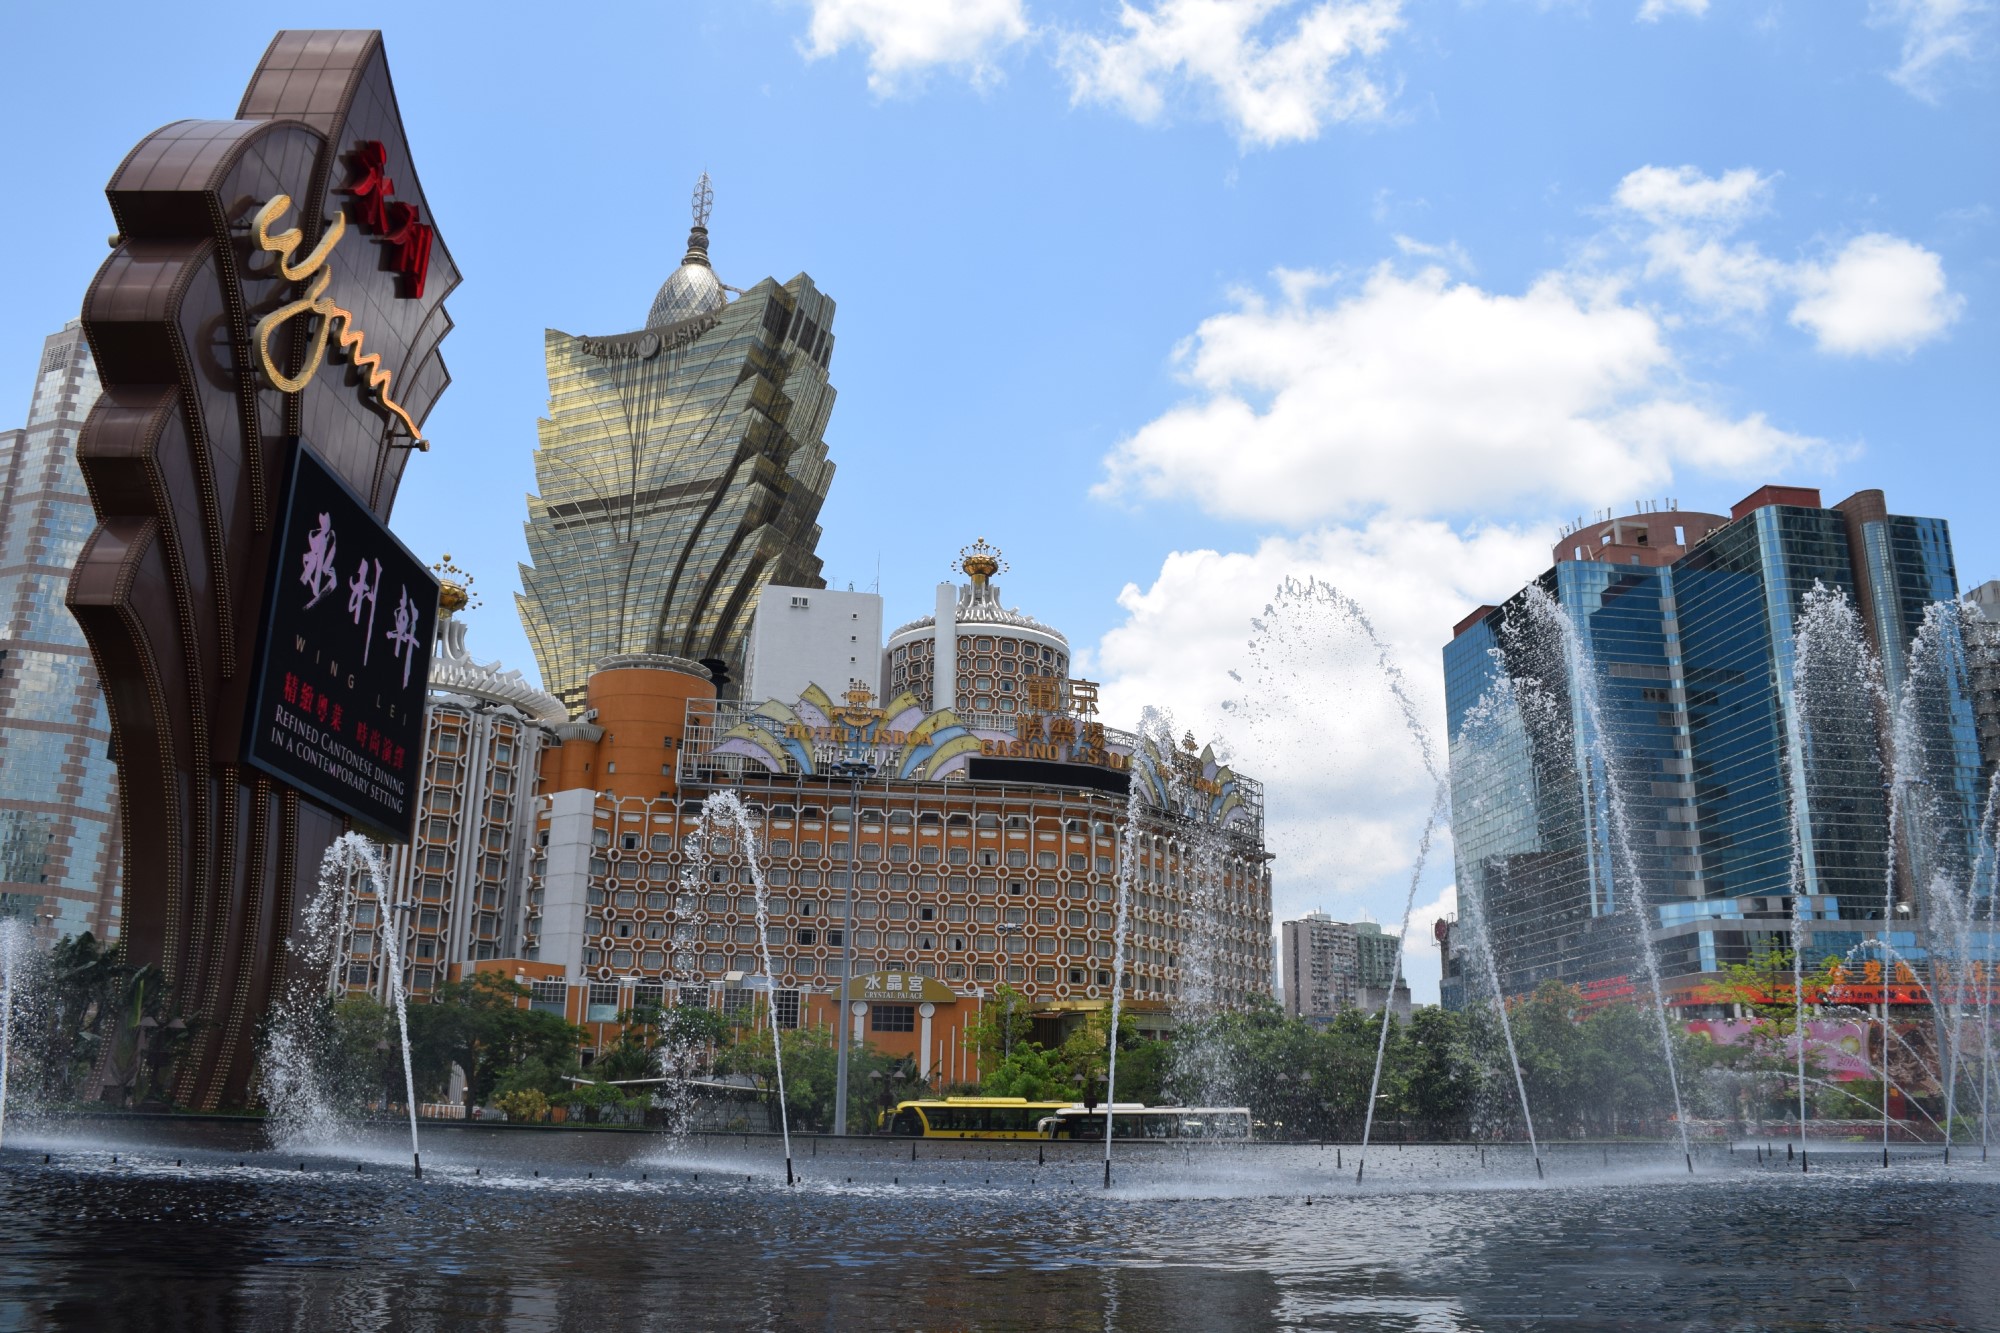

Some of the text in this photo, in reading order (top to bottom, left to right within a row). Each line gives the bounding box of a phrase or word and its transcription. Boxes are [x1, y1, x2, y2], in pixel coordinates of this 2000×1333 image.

[582, 316, 722, 358] GRAND LISBOA
[296, 634, 407, 726] WING LEI
[1028, 674, 1100, 715] 葡京
[275, 704, 405, 796] REFINED CANTONESE DINING
[784, 725, 934, 746] HOTEL LISBOA
[981, 739, 1059, 761] CASINO
[271, 727, 403, 814] IN A CONTEMPORARY SETTING
[864, 991, 896, 999] CRYSTAL
[865, 974, 924, 991] 水晶宮
